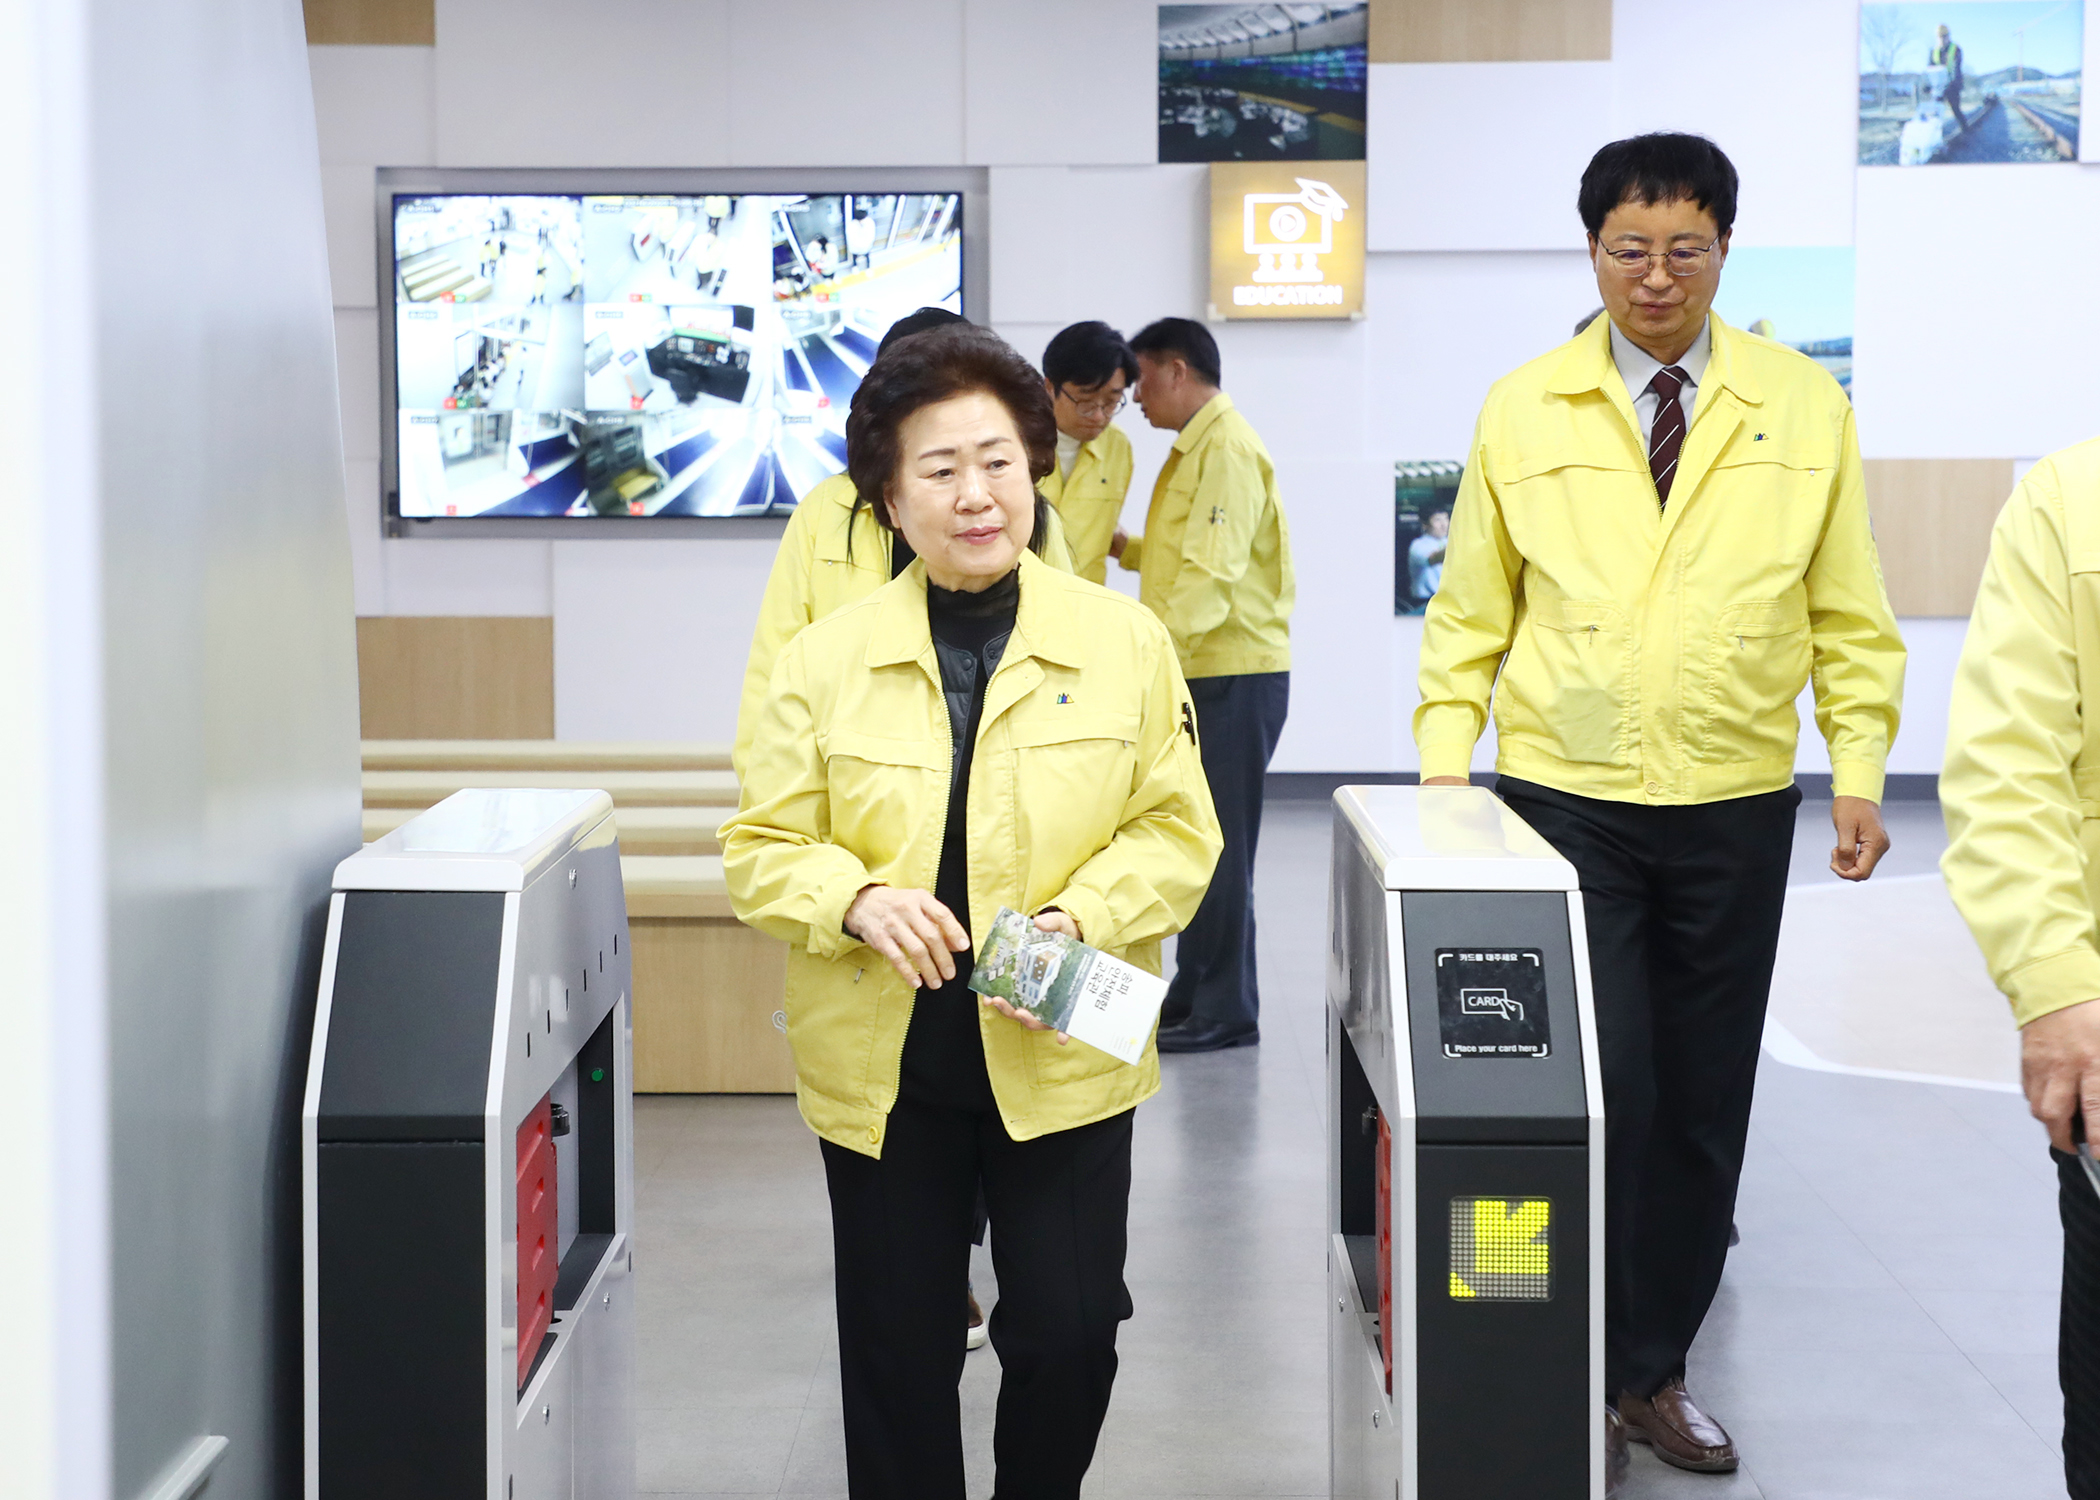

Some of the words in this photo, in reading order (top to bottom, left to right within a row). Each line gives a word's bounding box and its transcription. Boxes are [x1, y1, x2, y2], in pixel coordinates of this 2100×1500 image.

[1233, 285, 1343, 306] EDUCATION
[1459, 953, 1483, 962] 카드를
[1086, 961, 1109, 995] 교육관
[1094, 966, 1122, 1011] 안전체험
[1116, 972, 1133, 995] 송파
[1468, 996, 1500, 1006] CARD
[1454, 1044, 1477, 1053] Place
[1478, 1045, 1497, 1054] your
[1498, 1044, 1517, 1053] card
[1518, 1044, 1538, 1053] here
